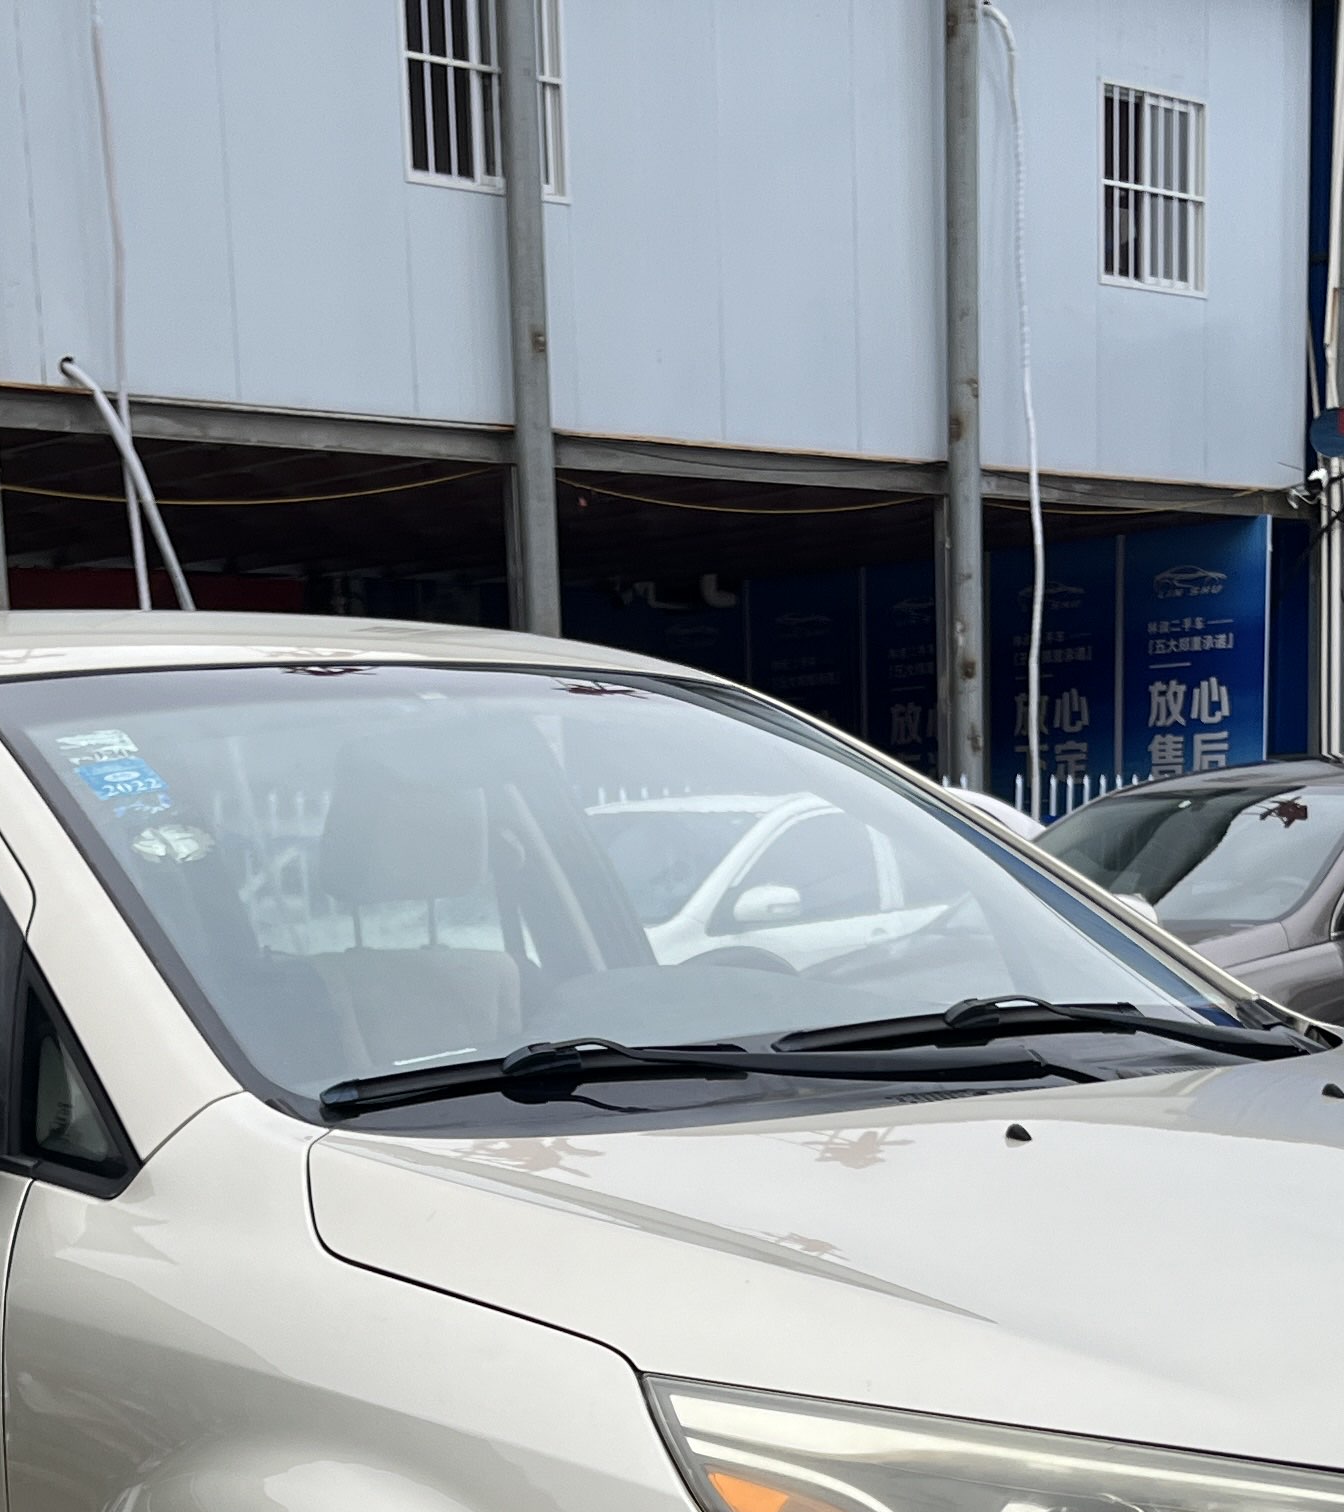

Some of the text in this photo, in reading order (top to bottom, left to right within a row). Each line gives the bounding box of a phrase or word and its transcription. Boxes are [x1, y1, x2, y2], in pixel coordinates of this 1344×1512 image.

[1148, 676, 1231, 728] 放心
[1147, 731, 1230, 781] 售后
[103, 778, 161, 797] 2022
